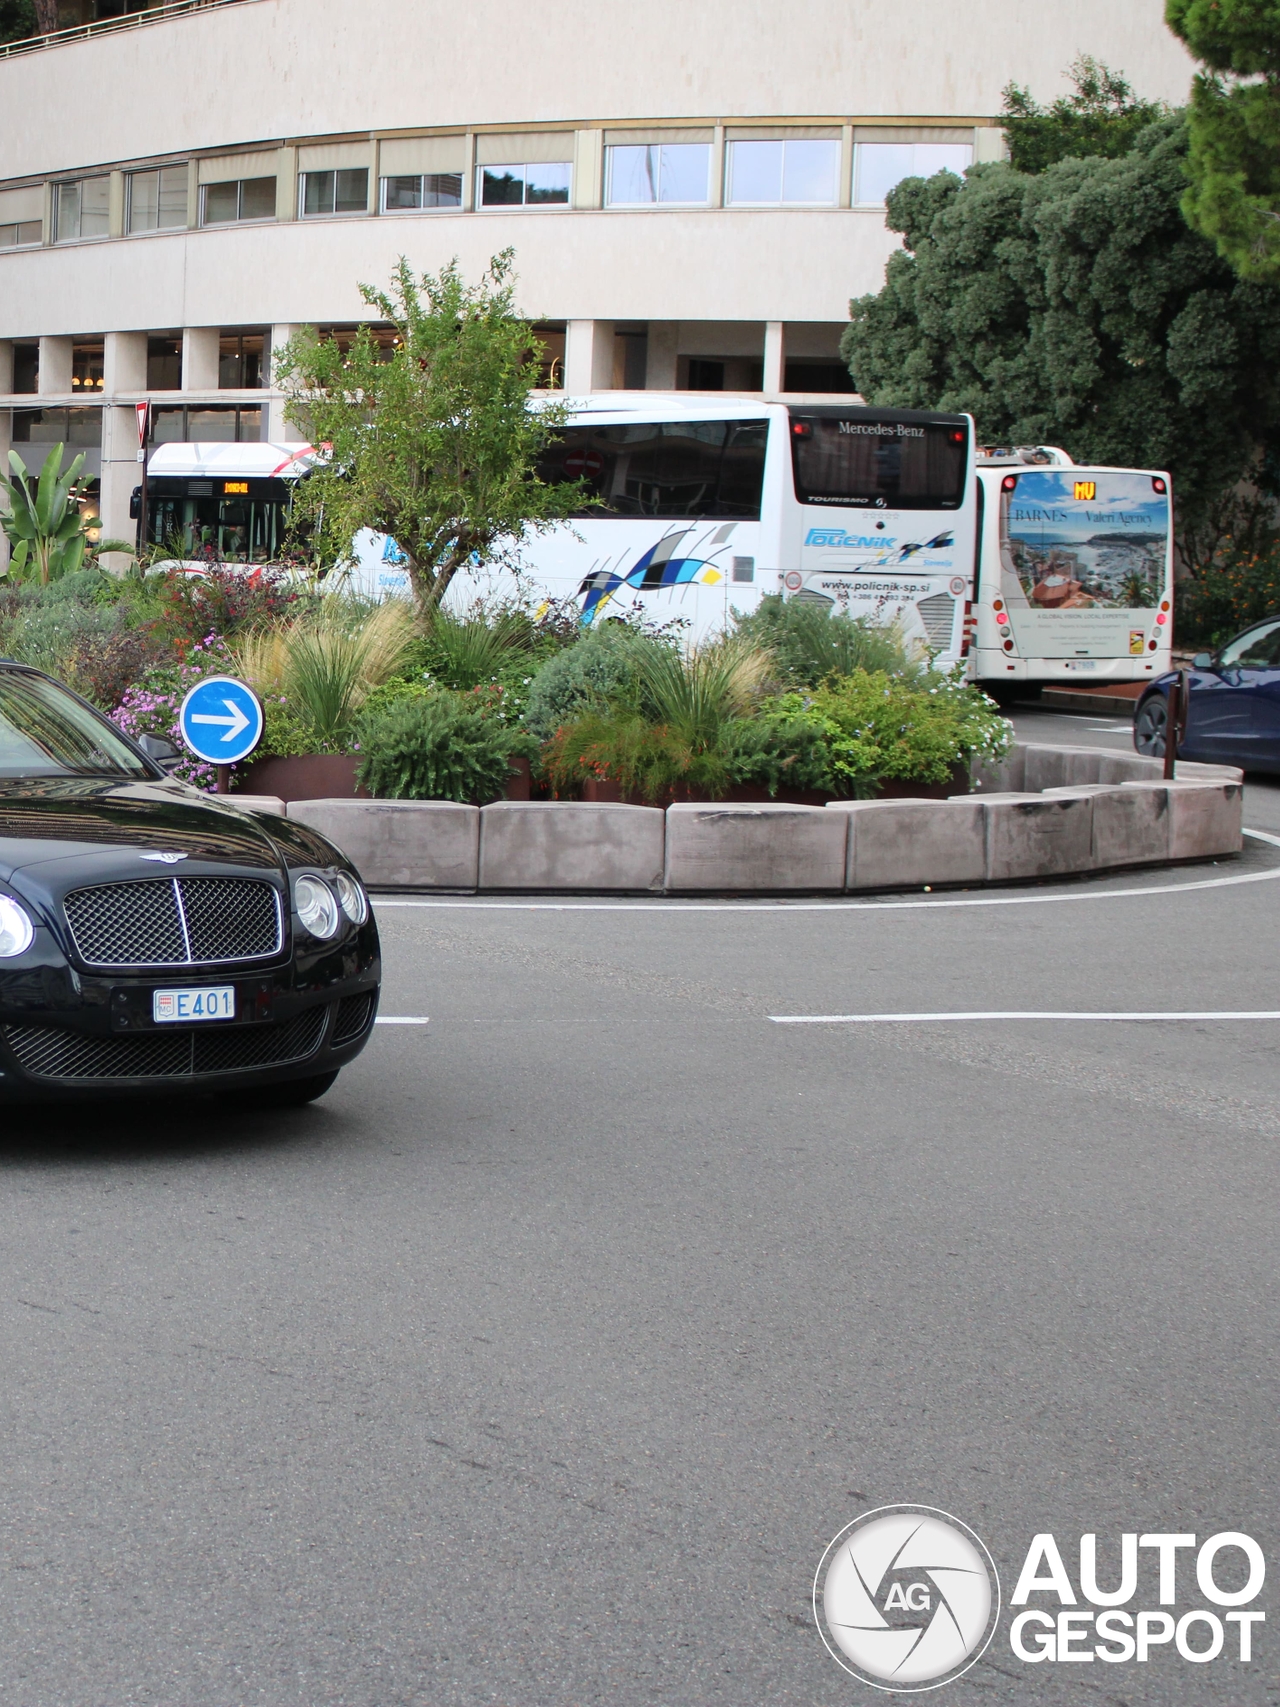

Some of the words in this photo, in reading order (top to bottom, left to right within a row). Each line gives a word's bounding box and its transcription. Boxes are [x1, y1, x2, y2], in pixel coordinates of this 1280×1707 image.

[839, 421, 925, 438] Mercedes-Benz
[1075, 482, 1095, 500] MV
[807, 496, 869, 504] TOURISMO
[1016, 509, 1068, 522] BARNES
[1085, 510, 1115, 524] Valeri
[1117, 510, 1153, 527] Agency
[821, 581, 930, 594] www.policnik-sp.si
[177, 992, 229, 1017] E401
